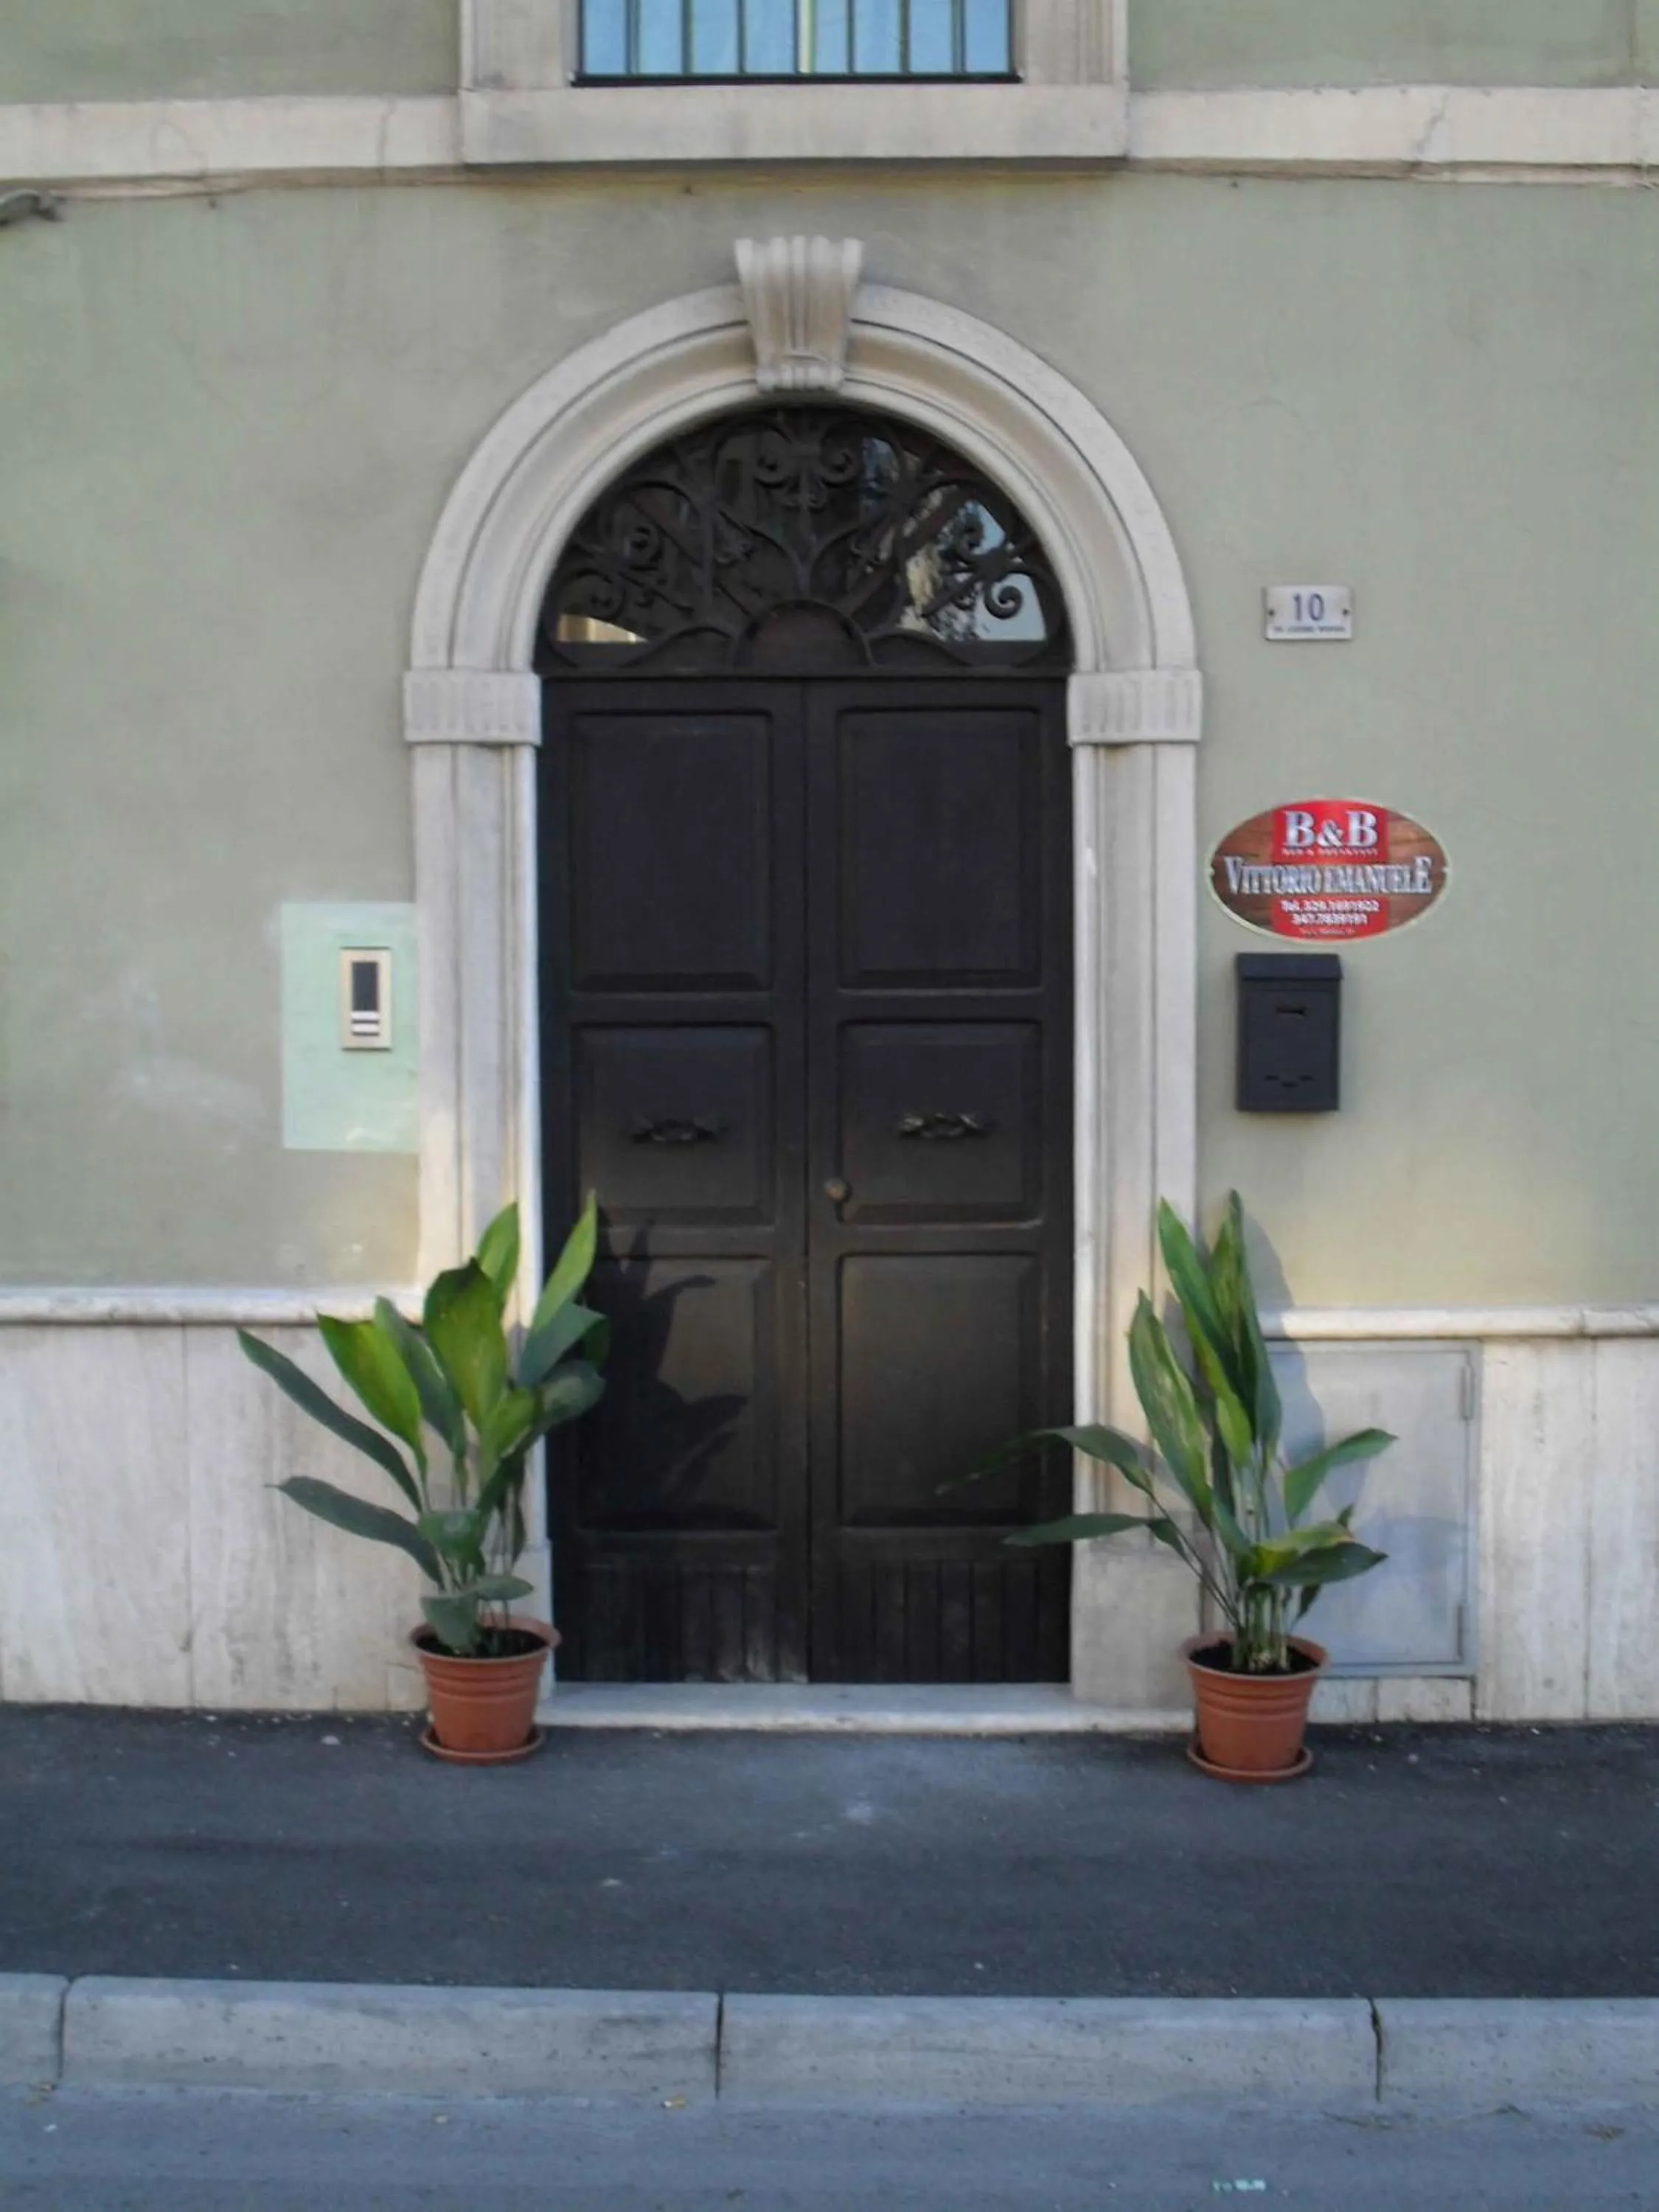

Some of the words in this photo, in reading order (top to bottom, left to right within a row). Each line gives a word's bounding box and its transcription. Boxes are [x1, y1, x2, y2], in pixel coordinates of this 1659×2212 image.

[1293, 592, 1325, 621] 10
[1282, 810, 1378, 848] B&B
[1323, 856, 1433, 894] EMANUELE
